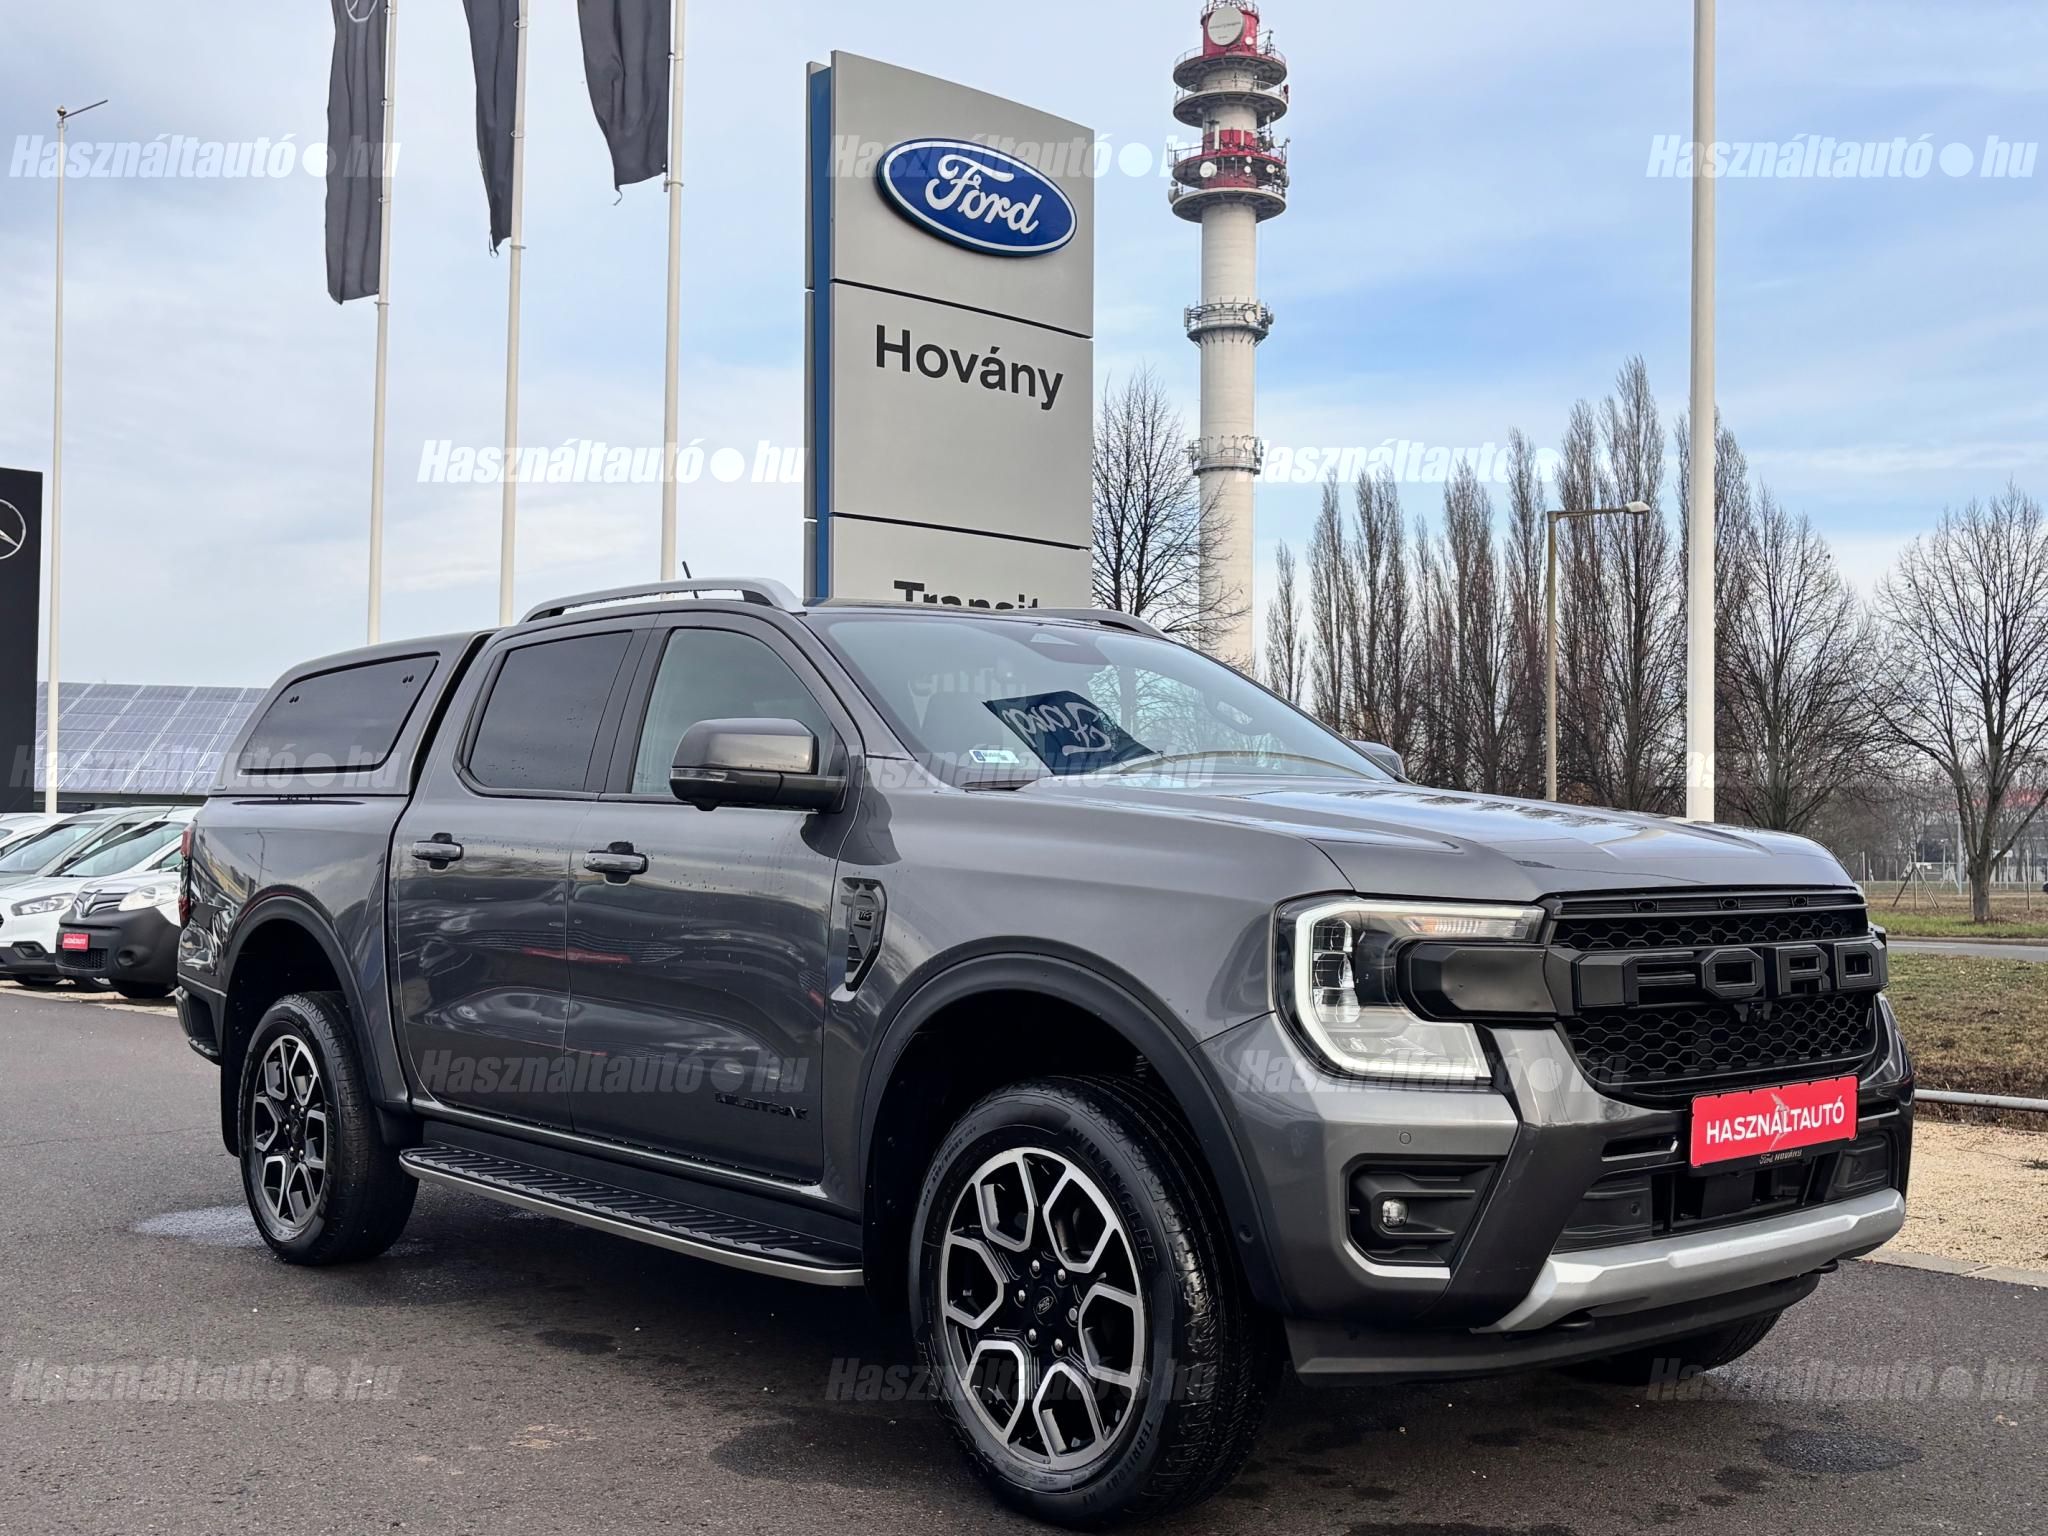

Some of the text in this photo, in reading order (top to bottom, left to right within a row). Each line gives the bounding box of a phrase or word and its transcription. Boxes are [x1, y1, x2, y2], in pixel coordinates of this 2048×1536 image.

[924, 153, 1041, 235] Ford
[876, 325, 1063, 410] Hovány
[1579, 939, 1887, 1008] FORD
[1706, 1095, 1845, 1144] HASZNÁLTAUTÓ
